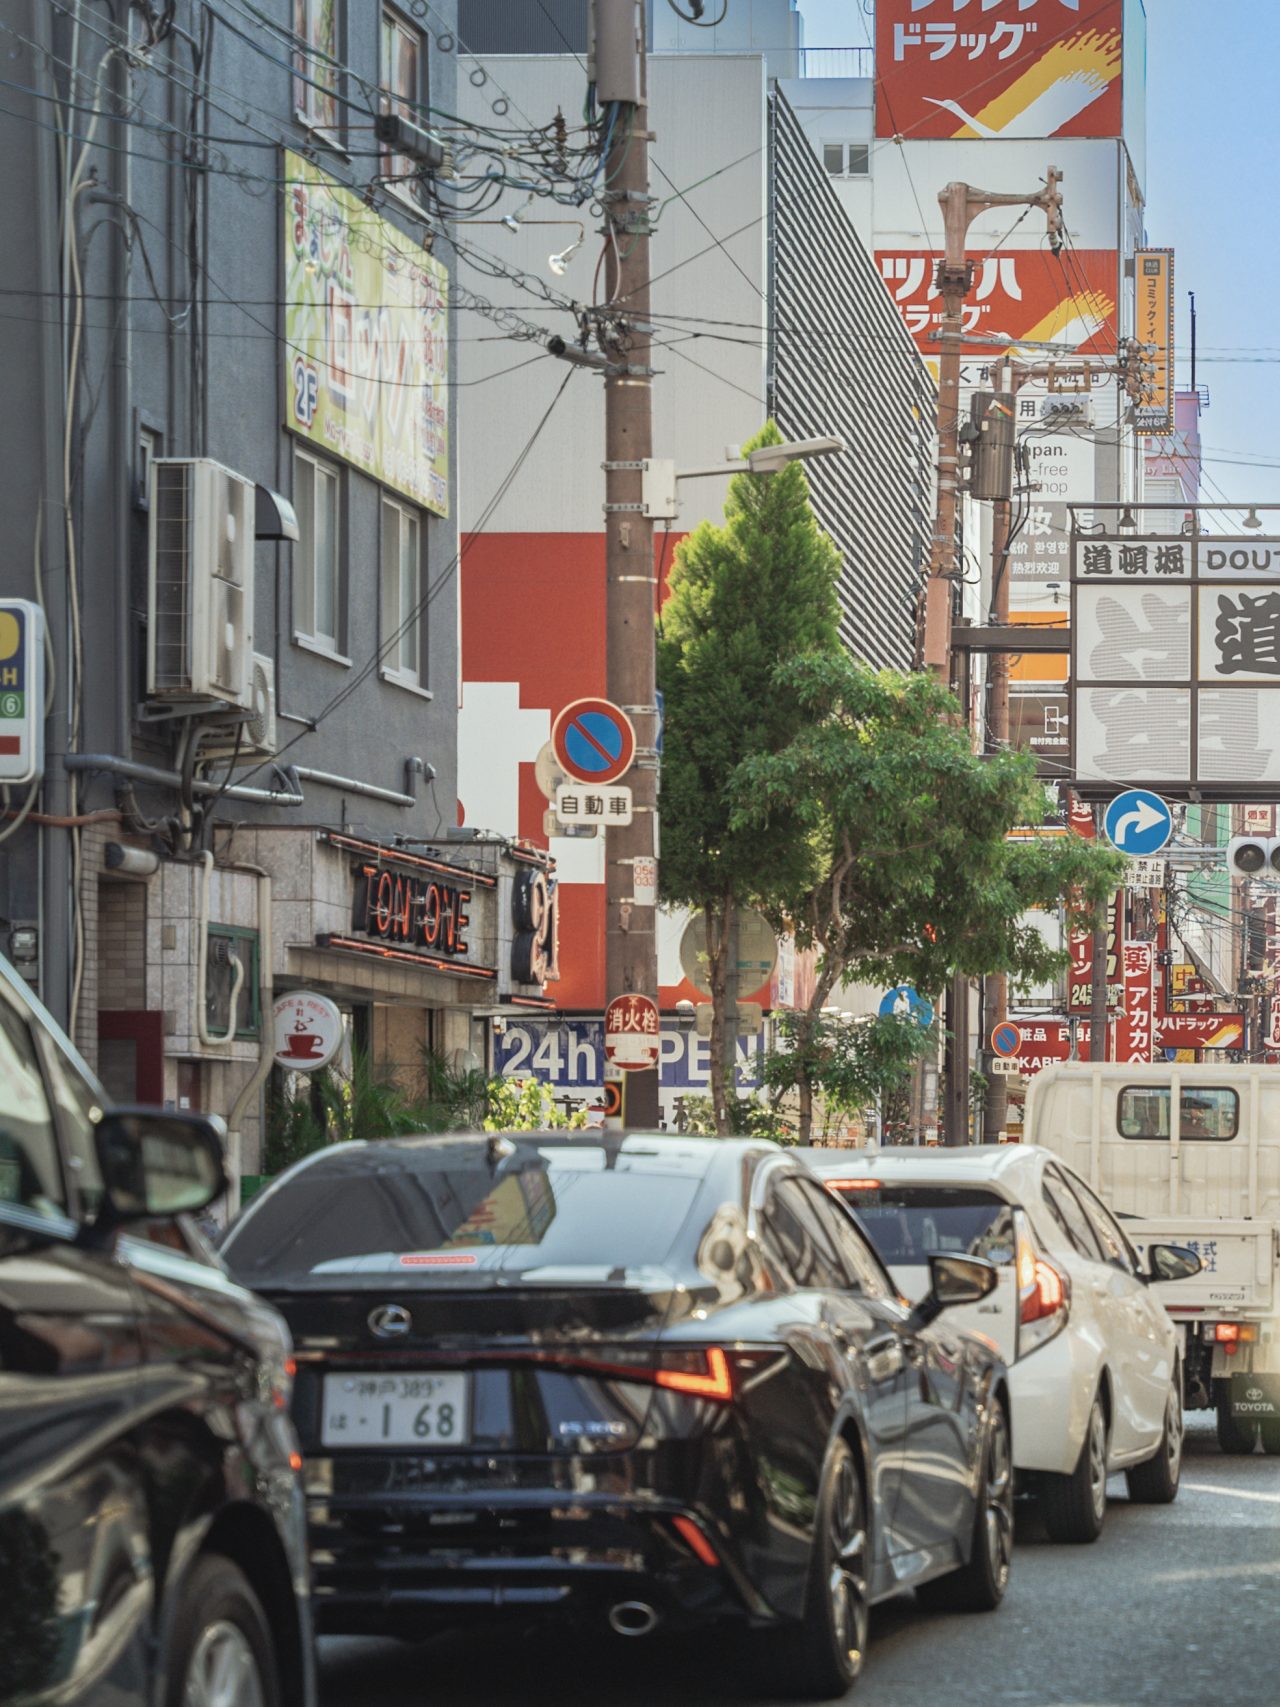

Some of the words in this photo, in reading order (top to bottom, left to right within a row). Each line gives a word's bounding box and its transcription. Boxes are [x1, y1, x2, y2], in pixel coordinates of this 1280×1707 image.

[893, 21, 1037, 61] ドラッグ
[881, 257, 1022, 301] ツハ
[294, 353, 318, 432] 2F
[1083, 544, 1185, 575] 道頓堀
[562, 795, 628, 816] 自動車
[1125, 945, 1148, 974] 薬
[608, 1008, 657, 1033] 消火栓
[1128, 986, 1150, 1064] アカカベ
[501, 1027, 596, 1081] 24h
[658, 1030, 758, 1081] PEN
[1235, 1402, 1275, 1412] TOYOTA
